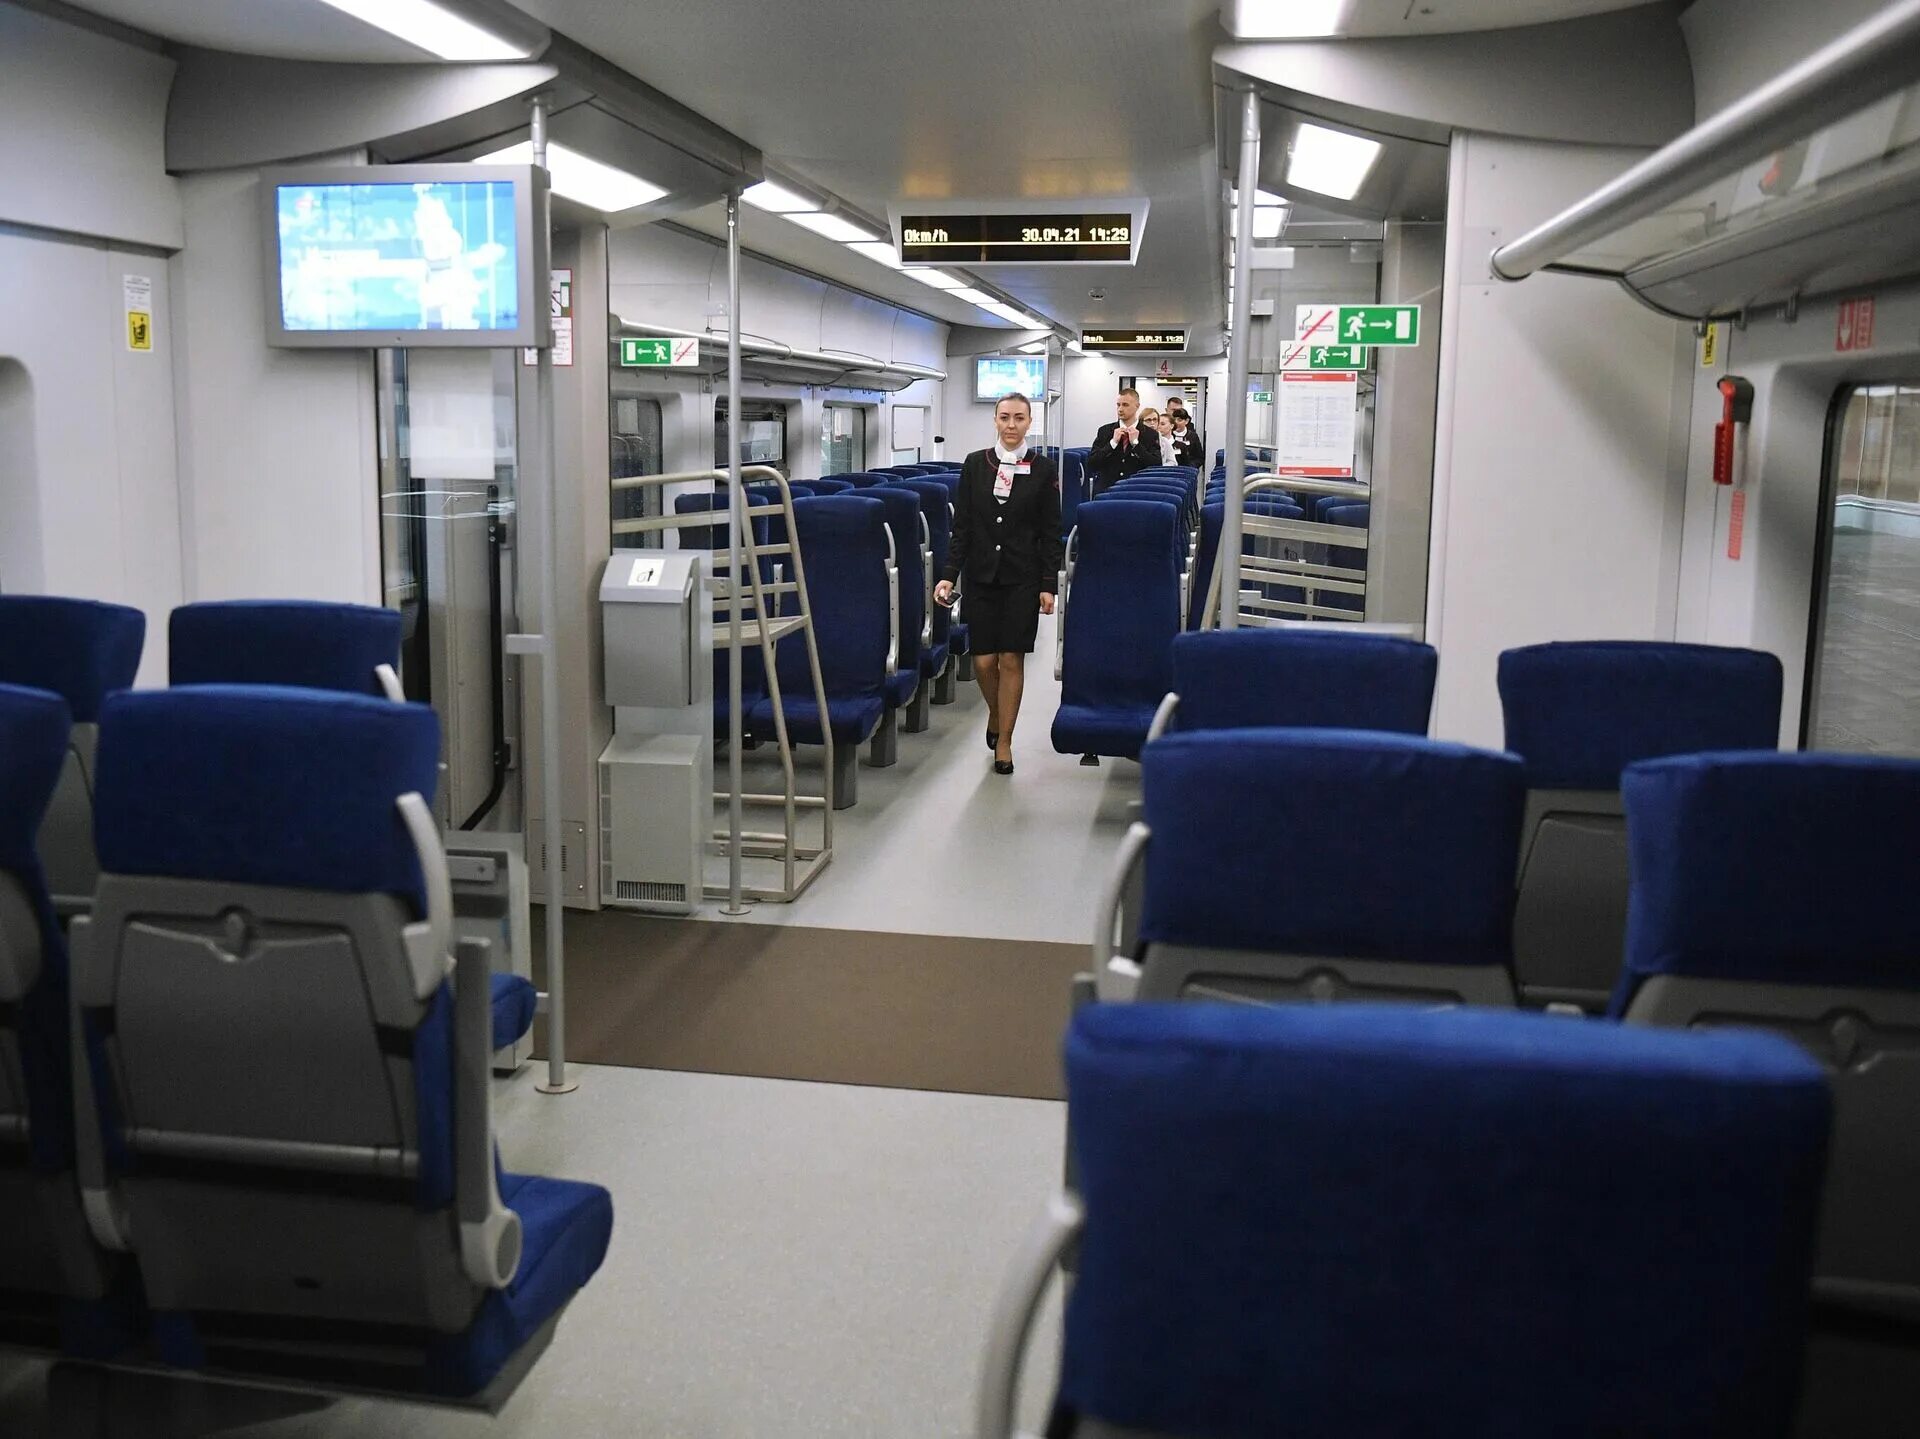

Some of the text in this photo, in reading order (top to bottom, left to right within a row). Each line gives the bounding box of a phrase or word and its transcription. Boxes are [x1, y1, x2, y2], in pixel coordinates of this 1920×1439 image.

[904, 227, 1129, 242] 0km/h 30.04.21 14:29
[1160, 359, 1168, 373] 4
